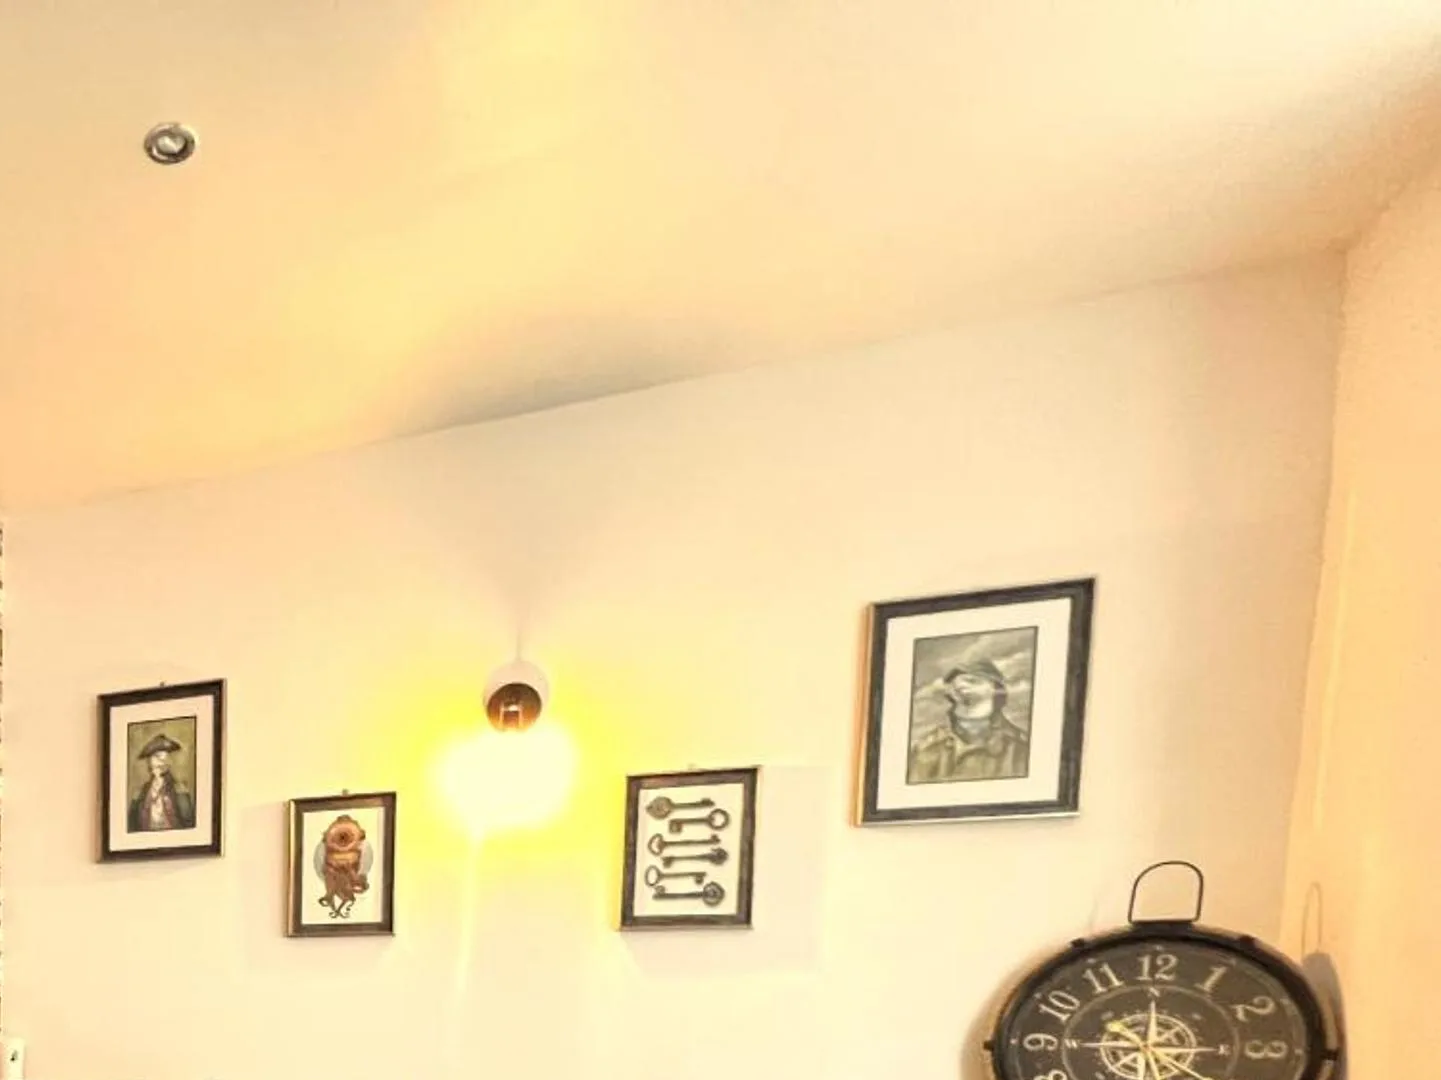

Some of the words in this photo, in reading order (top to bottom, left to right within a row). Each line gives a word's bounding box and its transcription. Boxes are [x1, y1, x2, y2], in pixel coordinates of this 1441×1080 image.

[1082, 962, 1125, 995] 11
[1136, 954, 1178, 981] 12
[1194, 966, 1229, 992] 1
[1037, 989, 1081, 1022] 10
[1232, 995, 1276, 1022] 2
[1022, 1032, 1058, 1052] 9
[1244, 1039, 1289, 1060] 3
